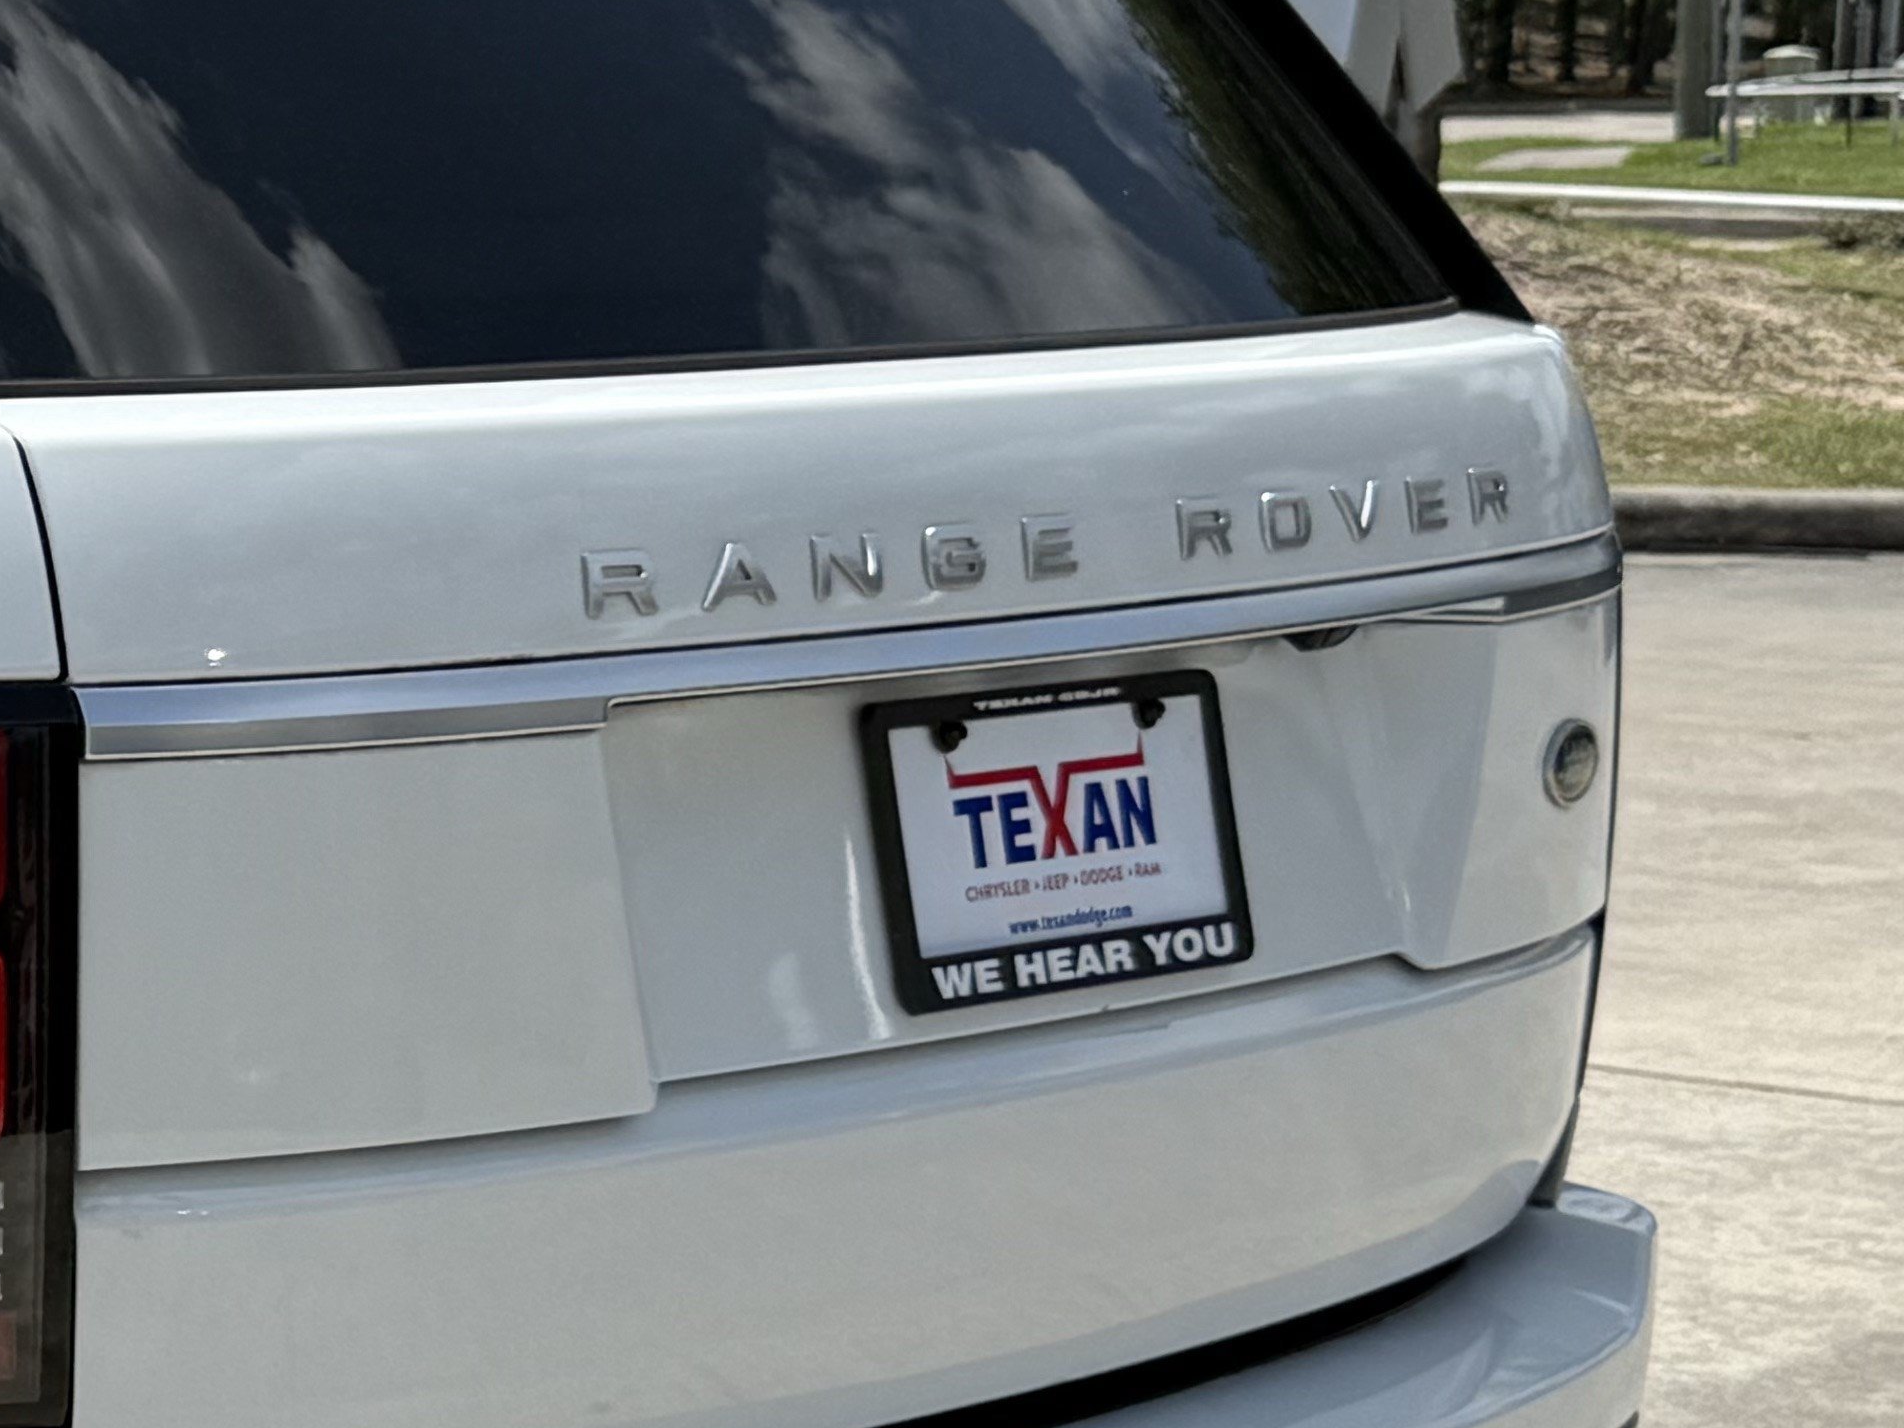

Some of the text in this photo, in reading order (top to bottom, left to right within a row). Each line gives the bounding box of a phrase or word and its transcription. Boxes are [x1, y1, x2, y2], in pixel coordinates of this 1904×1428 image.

[579, 465, 1512, 620] RANGE ROVER
[946, 748, 1158, 869] TEXAN
[965, 861, 1162, 903] CHRYSLER JEEP DODGE RAM
[931, 922, 1235, 1000] WE HEAR YOU
